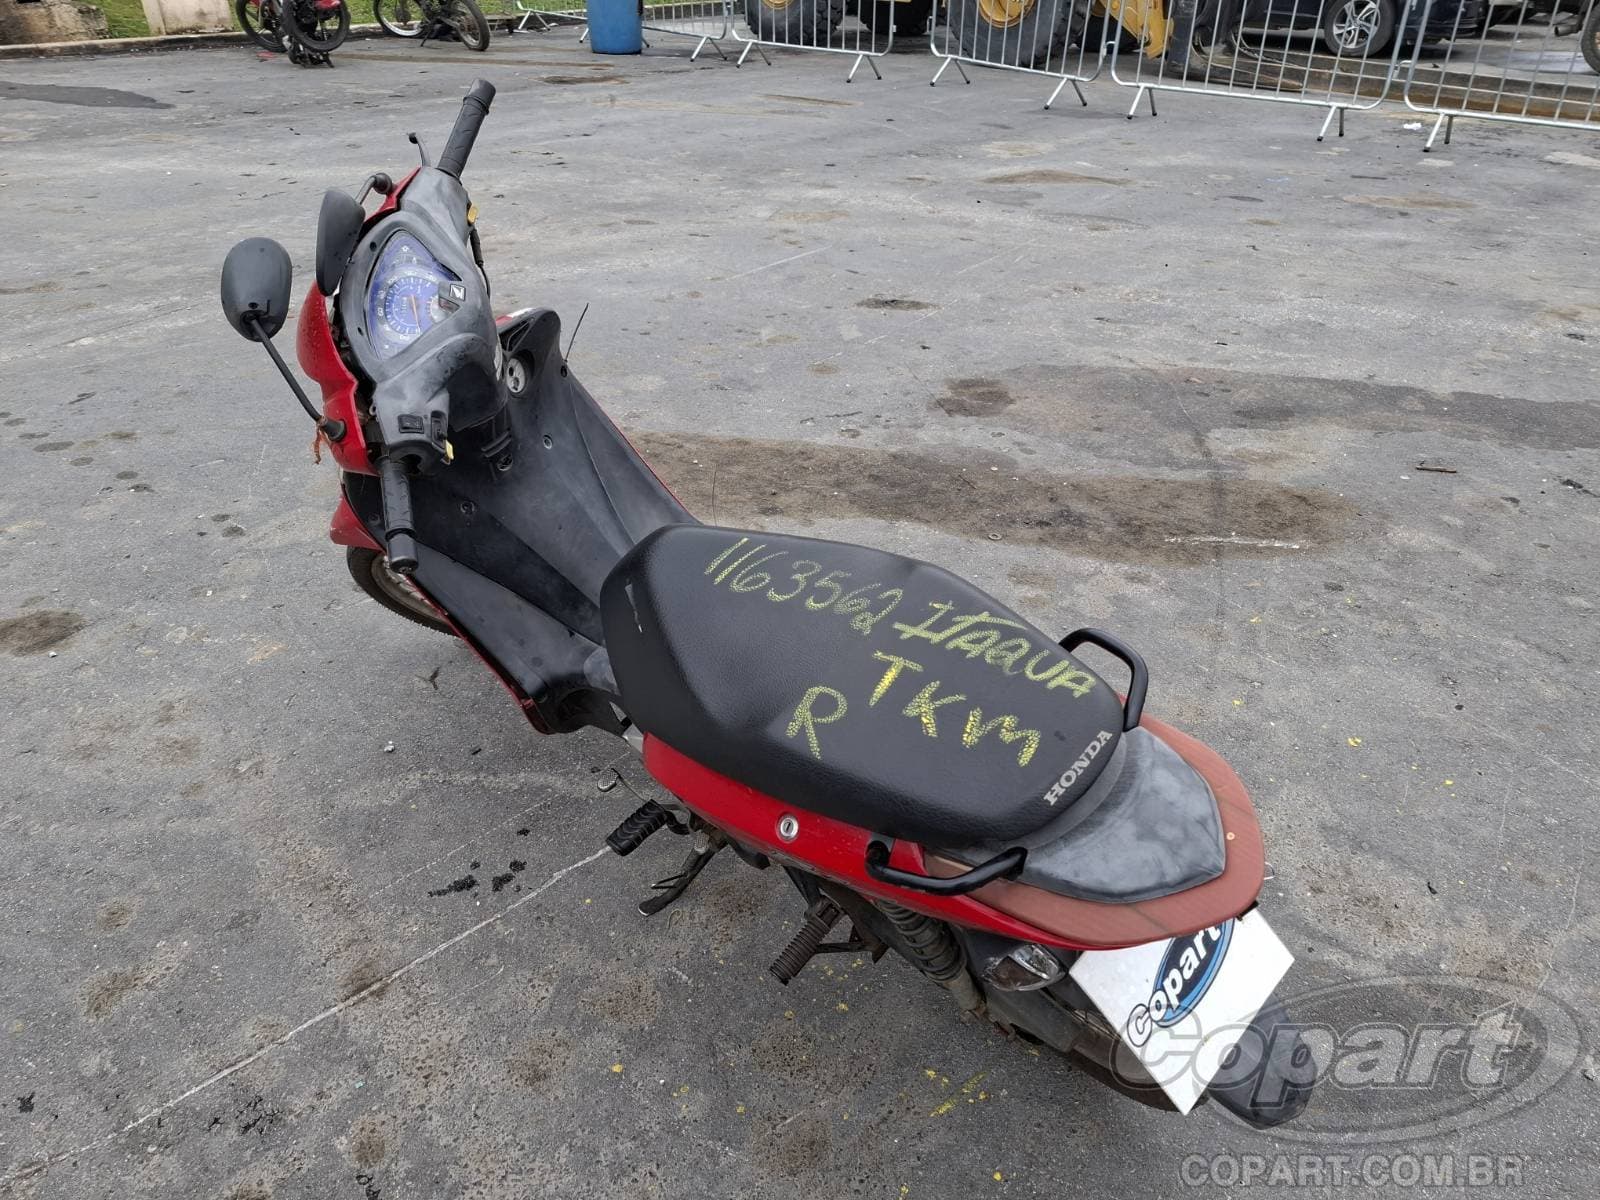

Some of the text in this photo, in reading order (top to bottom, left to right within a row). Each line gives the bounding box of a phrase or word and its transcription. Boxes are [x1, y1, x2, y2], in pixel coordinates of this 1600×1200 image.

[704, 537, 903, 635] 1163562
[786, 685, 848, 759] R
[1043, 730, 1112, 806] HONDA
